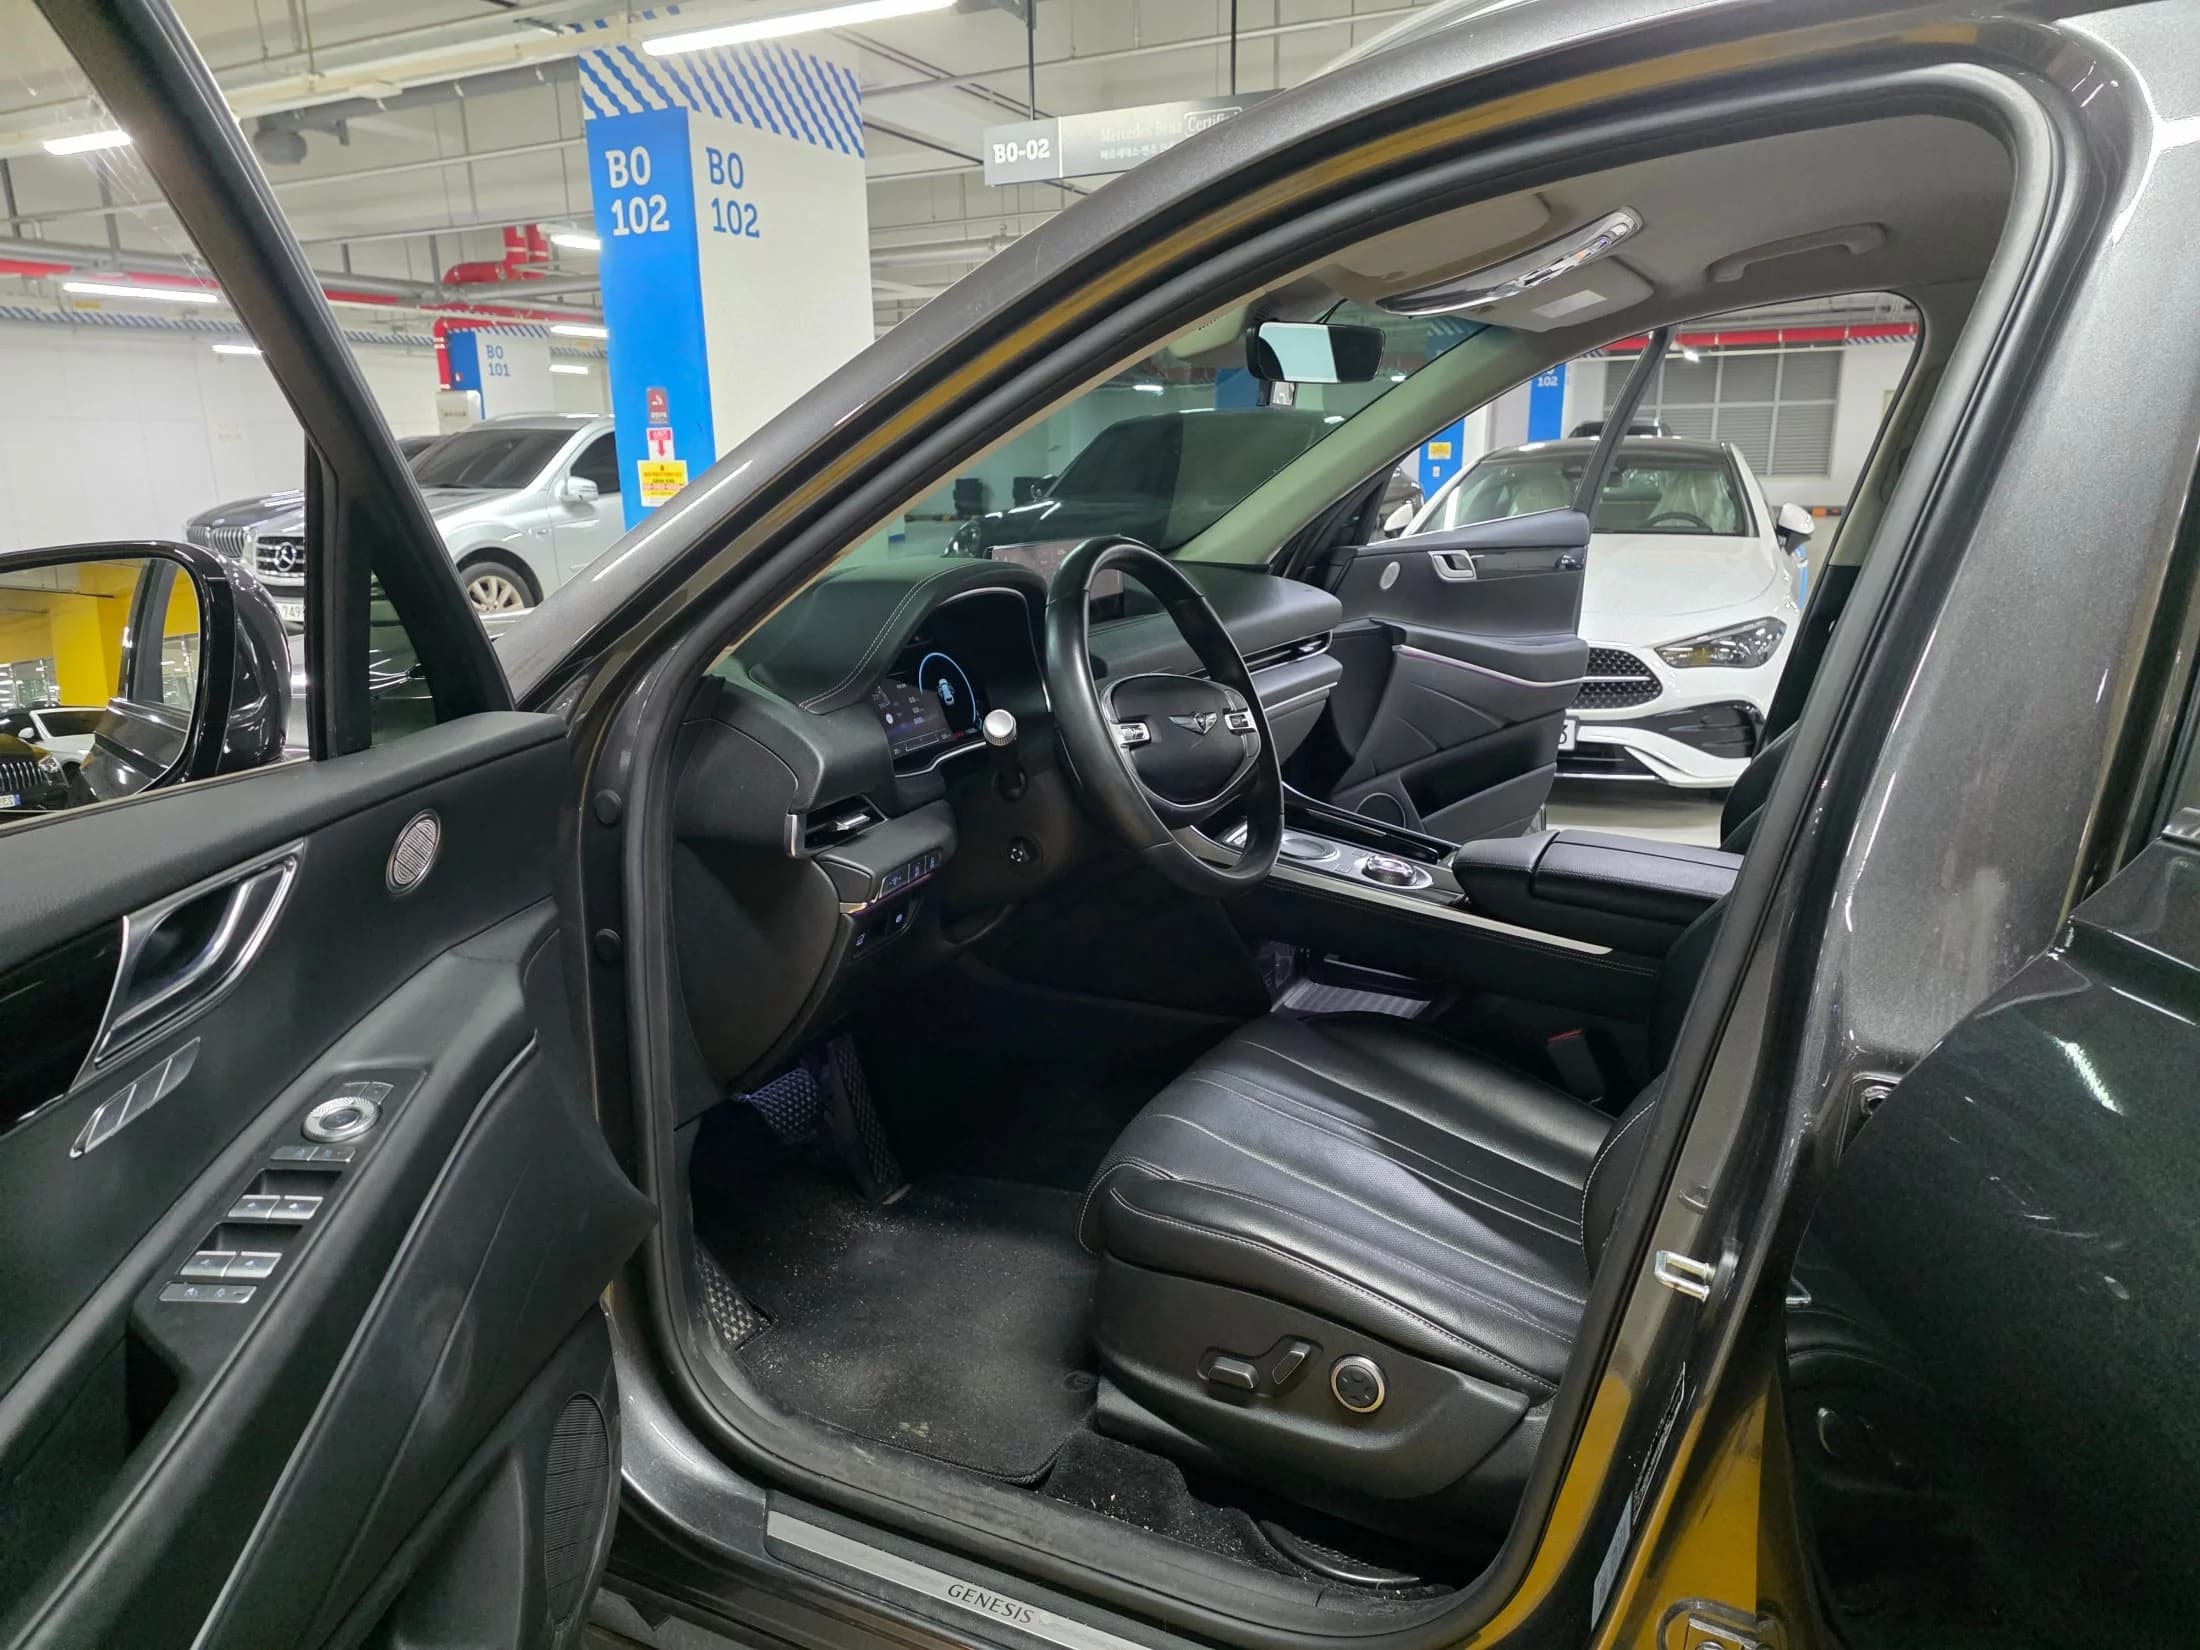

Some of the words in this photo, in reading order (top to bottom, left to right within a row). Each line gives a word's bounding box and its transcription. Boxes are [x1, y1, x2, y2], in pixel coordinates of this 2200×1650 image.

[611, 194, 670, 236] 102
[711, 198, 760, 238] 102
[489, 363, 511, 376] 101
[1537, 375, 1559, 387] 102
[947, 1583, 1035, 1624] GENESIS
